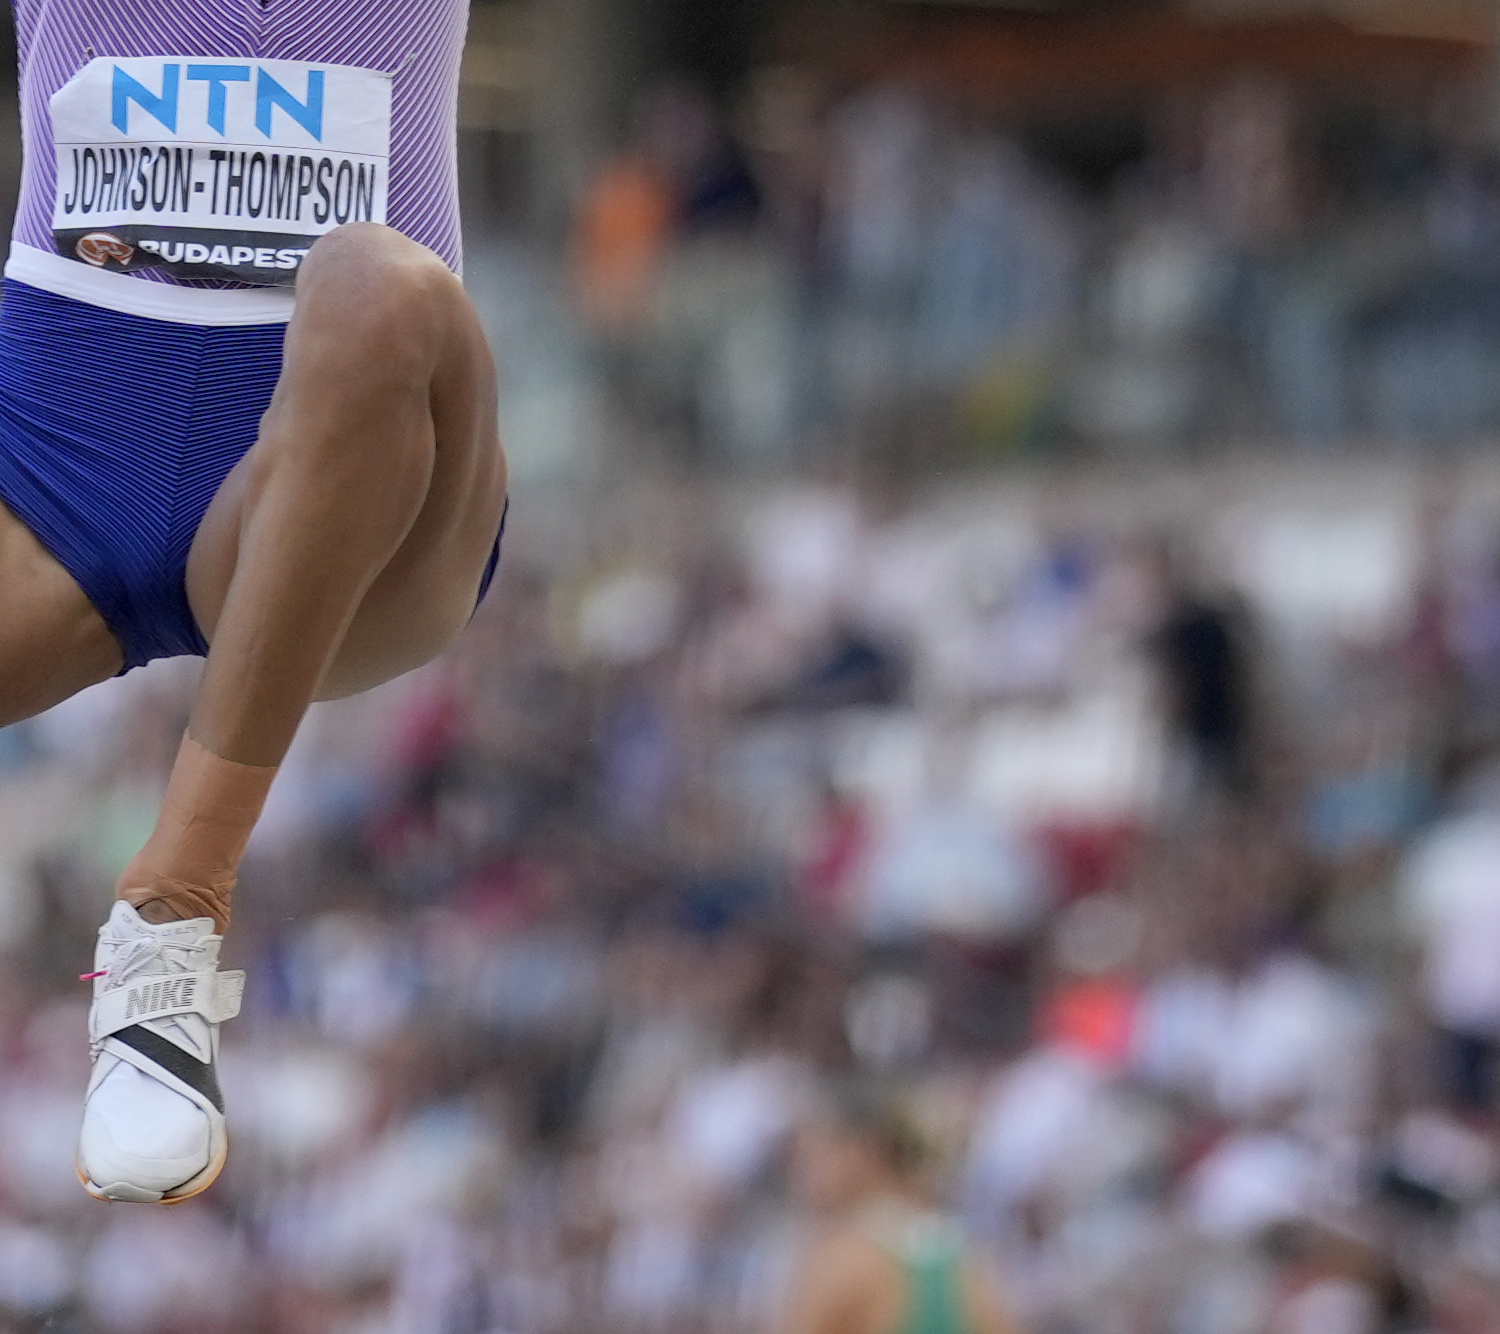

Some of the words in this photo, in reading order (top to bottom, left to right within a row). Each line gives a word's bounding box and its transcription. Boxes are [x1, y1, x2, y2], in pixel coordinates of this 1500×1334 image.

[112, 64, 325, 143] NTN
[65, 146, 376, 225] JOHNSON-THOMPSON
[126, 977, 197, 1019] NIKE
